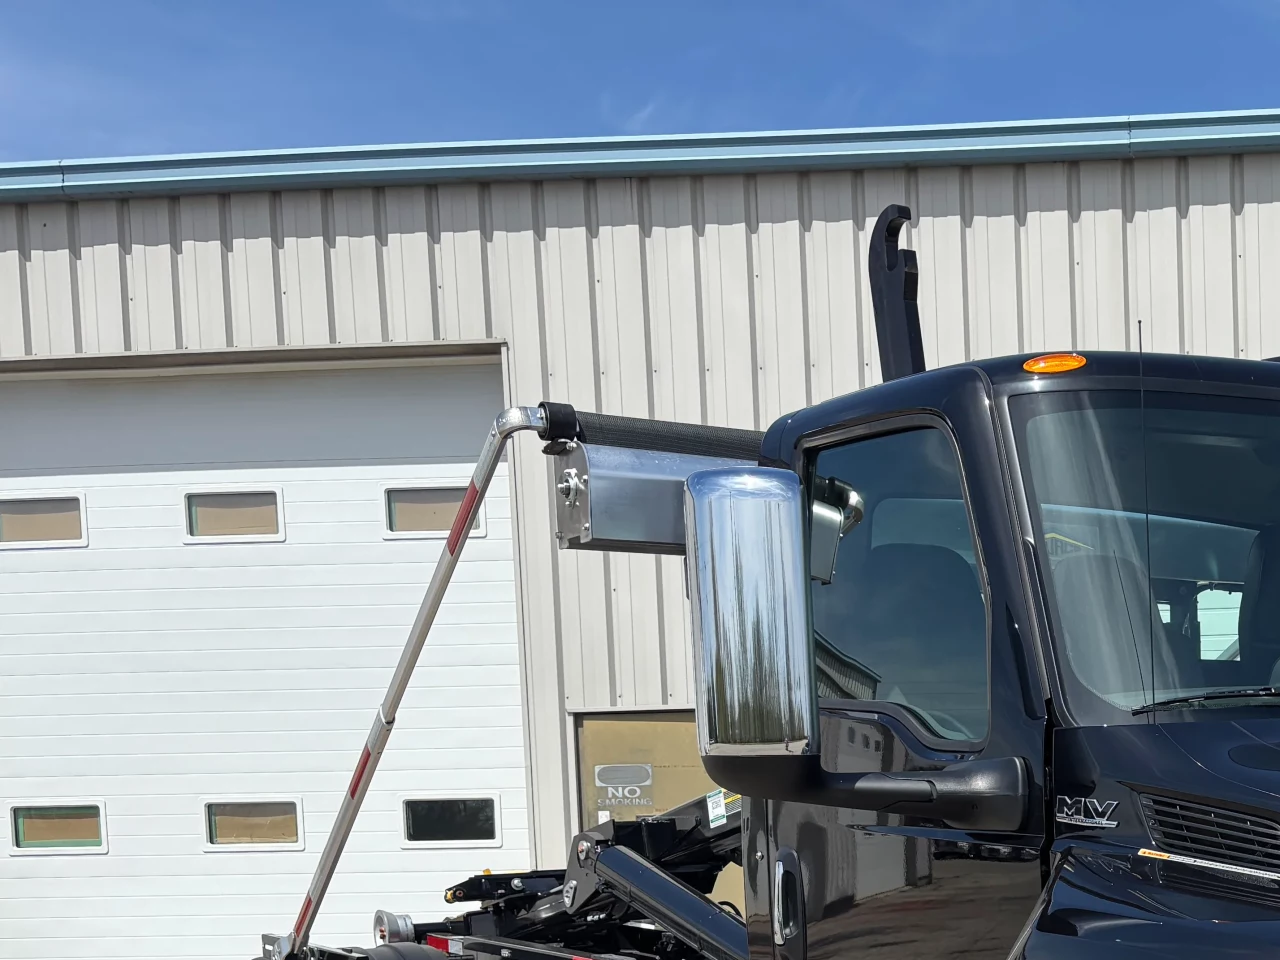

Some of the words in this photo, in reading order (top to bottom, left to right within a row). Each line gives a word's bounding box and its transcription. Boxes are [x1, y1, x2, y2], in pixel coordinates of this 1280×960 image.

[607, 786, 641, 798] NO
[597, 797, 653, 807] SMOKING
[1056, 795, 1119, 820] MV
